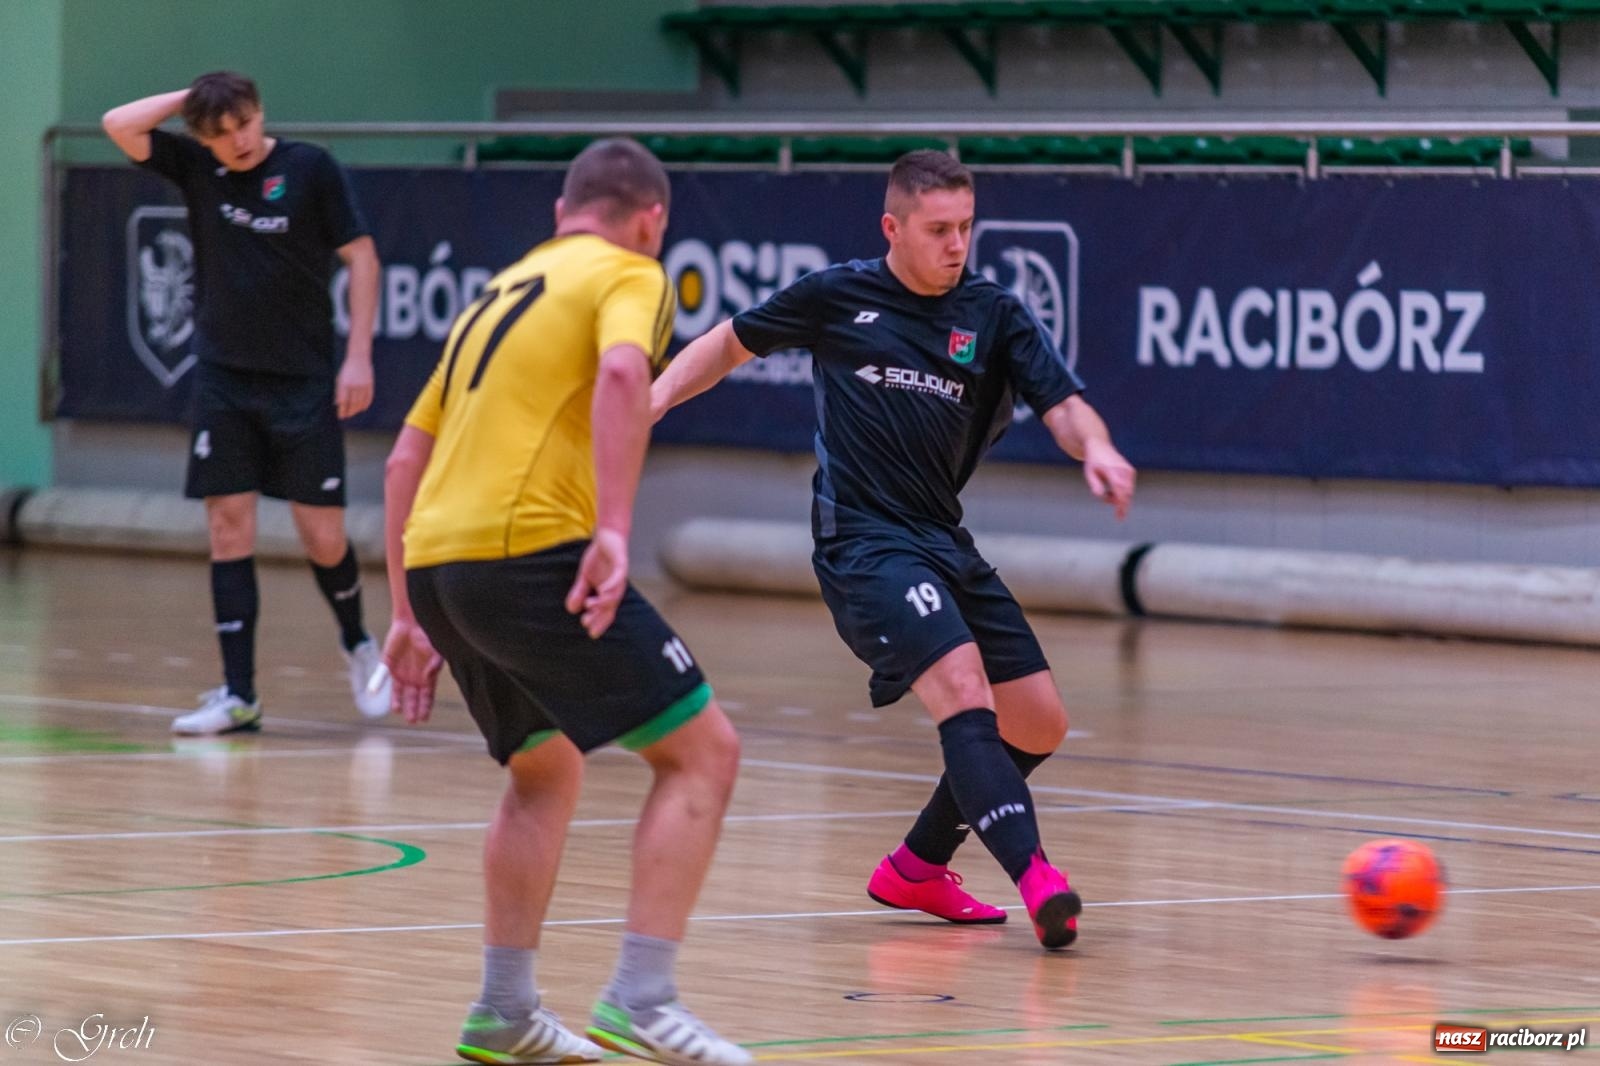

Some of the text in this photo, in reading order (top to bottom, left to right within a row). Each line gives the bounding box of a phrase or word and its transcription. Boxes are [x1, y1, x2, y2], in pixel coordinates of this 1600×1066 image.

[1136, 260, 1486, 373] RACIBÓRZ
[885, 366, 965, 398] SOLIDUM
[194, 430, 211, 459] 4
[904, 582, 942, 617] 19
